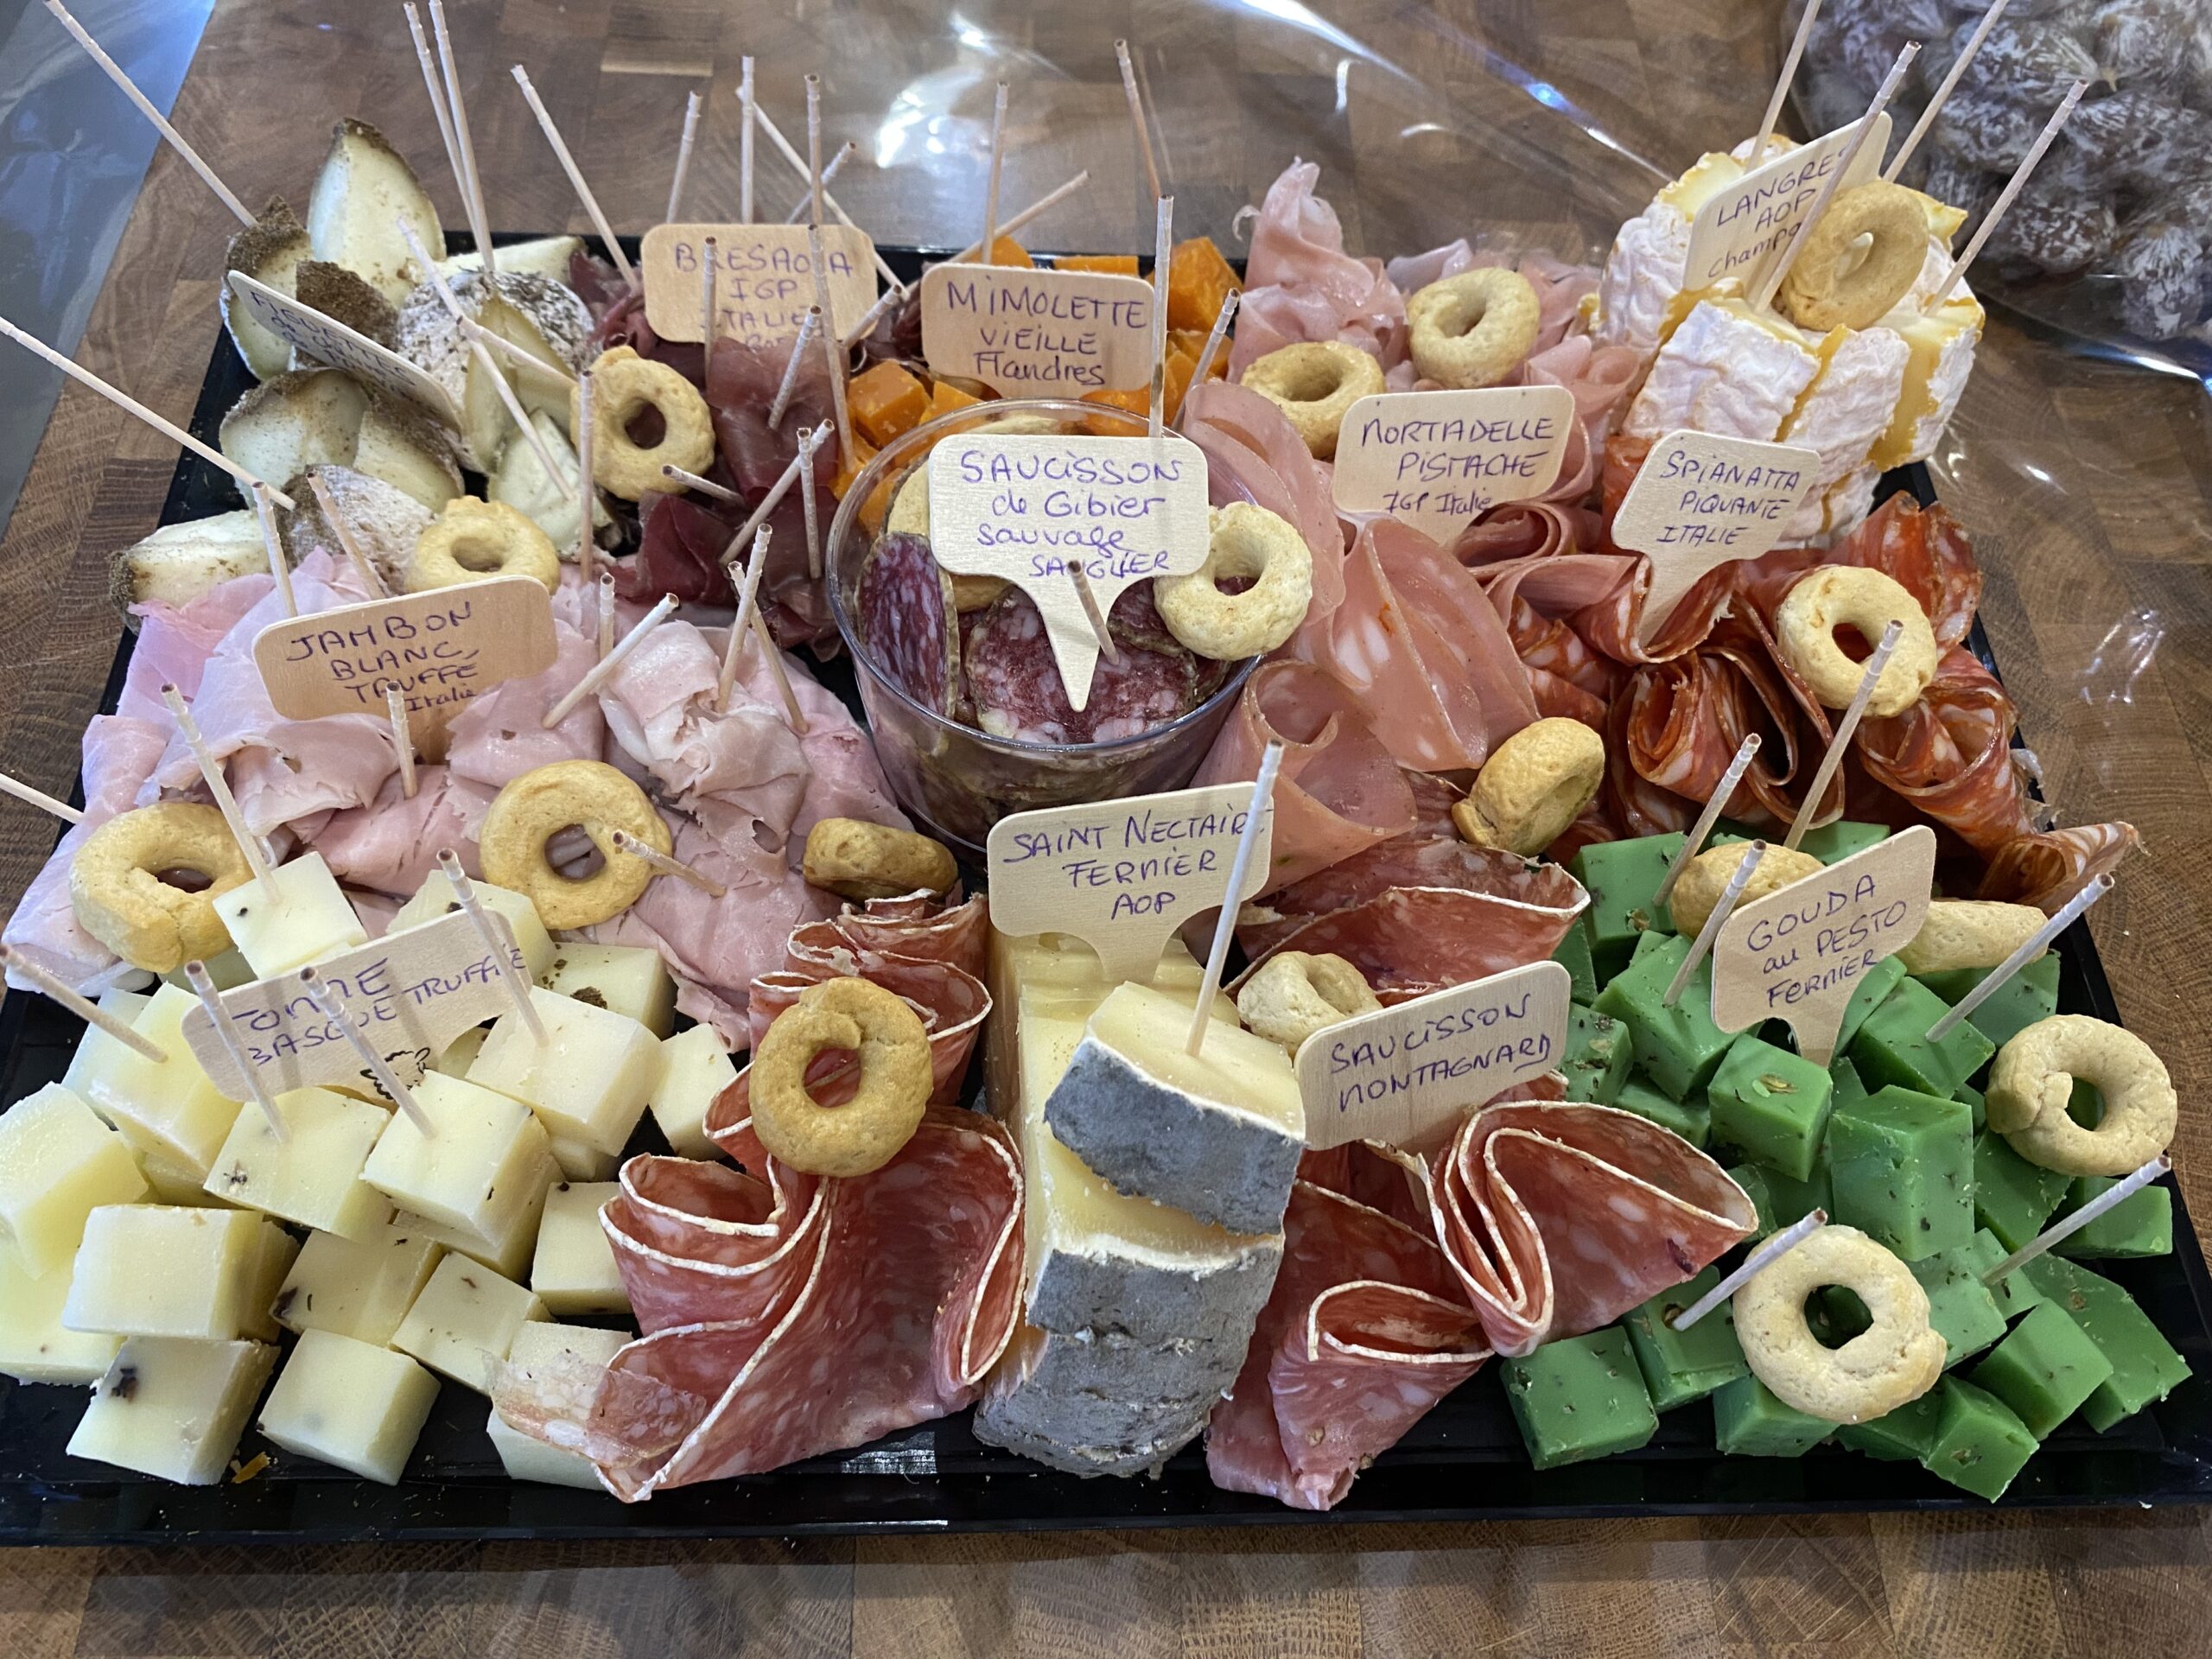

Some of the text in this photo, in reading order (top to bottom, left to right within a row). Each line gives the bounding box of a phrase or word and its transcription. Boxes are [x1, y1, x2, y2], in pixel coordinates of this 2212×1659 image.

[1717, 148, 1847, 227] LANGRE
[1756, 188, 1816, 232] AOP
[731, 278, 798, 301] IGP
[993, 490, 1166, 518] de Gibier
[1435, 486, 1492, 516] Italie
[1656, 525, 1748, 546] ITALIE
[1029, 550, 1169, 578] SAGLIER
[286, 601, 472, 661] JAMBON
[404, 683, 478, 711] Italie
[1003, 804, 1274, 862] SAINT NECTAIR
[1111, 892, 1176, 919] AOP
[1747, 874, 1876, 950] GOUDA
[1763, 900, 1907, 974] au PESTO
